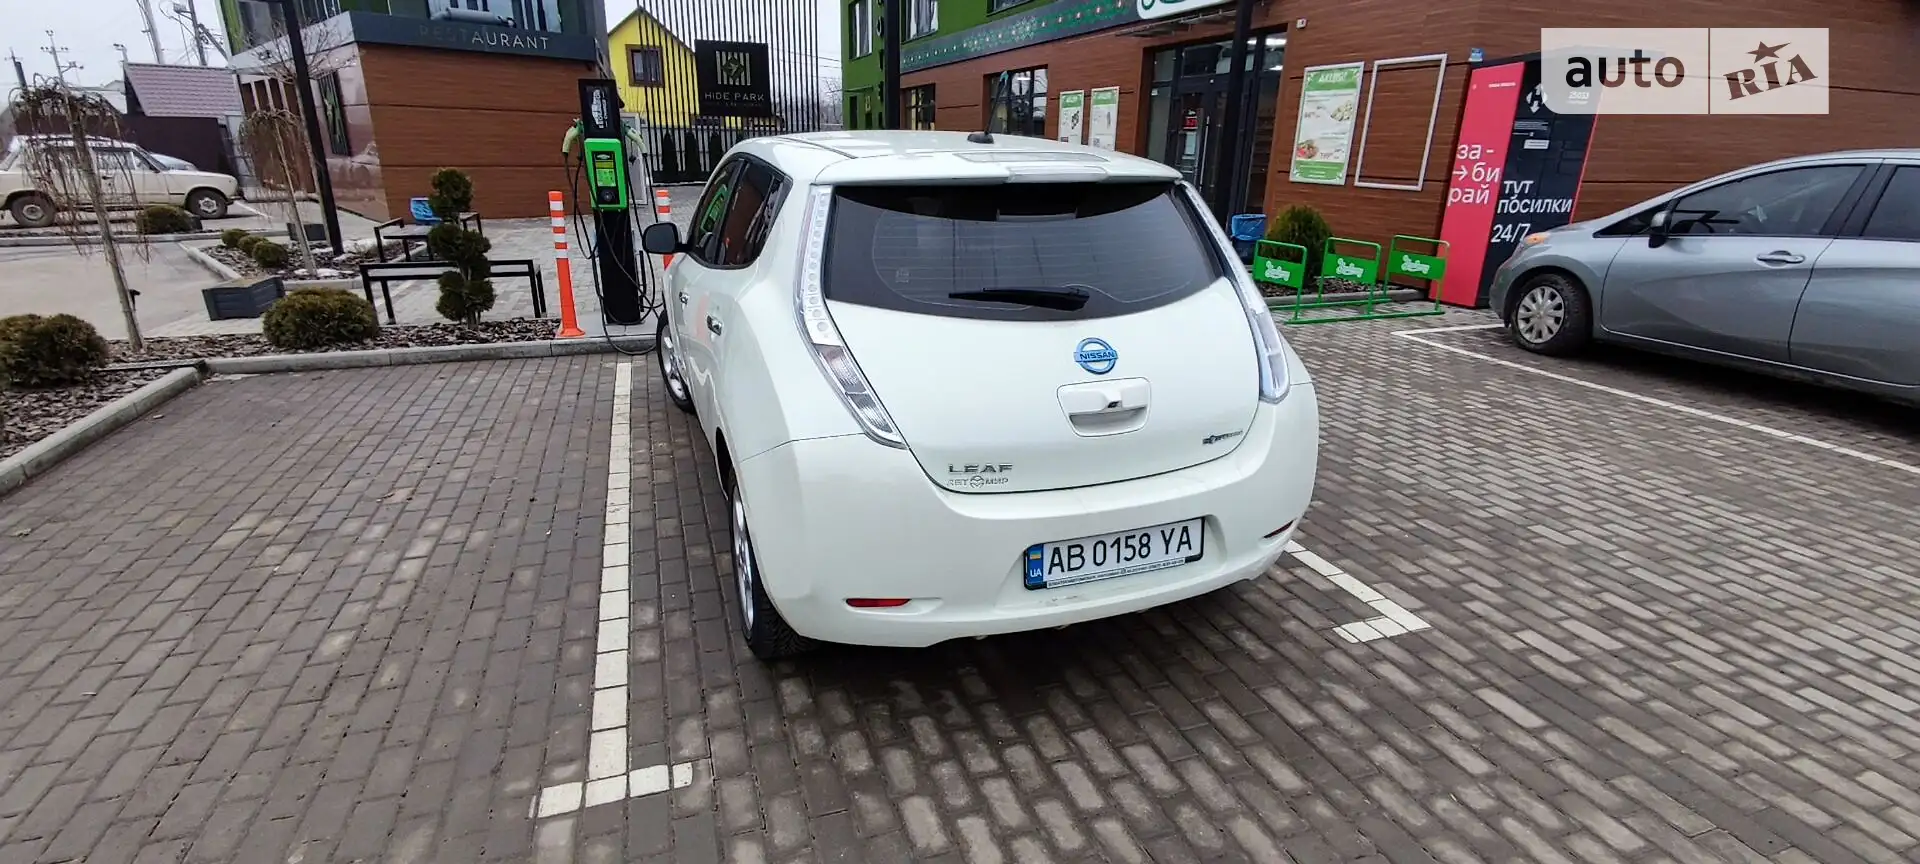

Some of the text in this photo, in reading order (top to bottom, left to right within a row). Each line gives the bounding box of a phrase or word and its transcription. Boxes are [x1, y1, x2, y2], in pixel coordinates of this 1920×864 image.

[704, 91, 765, 101] HIDE PARK
[1471, 161, 1501, 183] би
[1447, 183, 1490, 207] рай
[1503, 180, 1534, 200] тут
[1496, 198, 1573, 215] посилки
[1490, 222, 1532, 243] 24/7
[1079, 351, 1115, 360] NISSAN
[948, 463, 1014, 473] LEAF
[1047, 543, 1086, 576] AB
[1092, 532, 1151, 567] 0158
[1160, 525, 1192, 555] YA
[1029, 568, 1043, 578] UA
